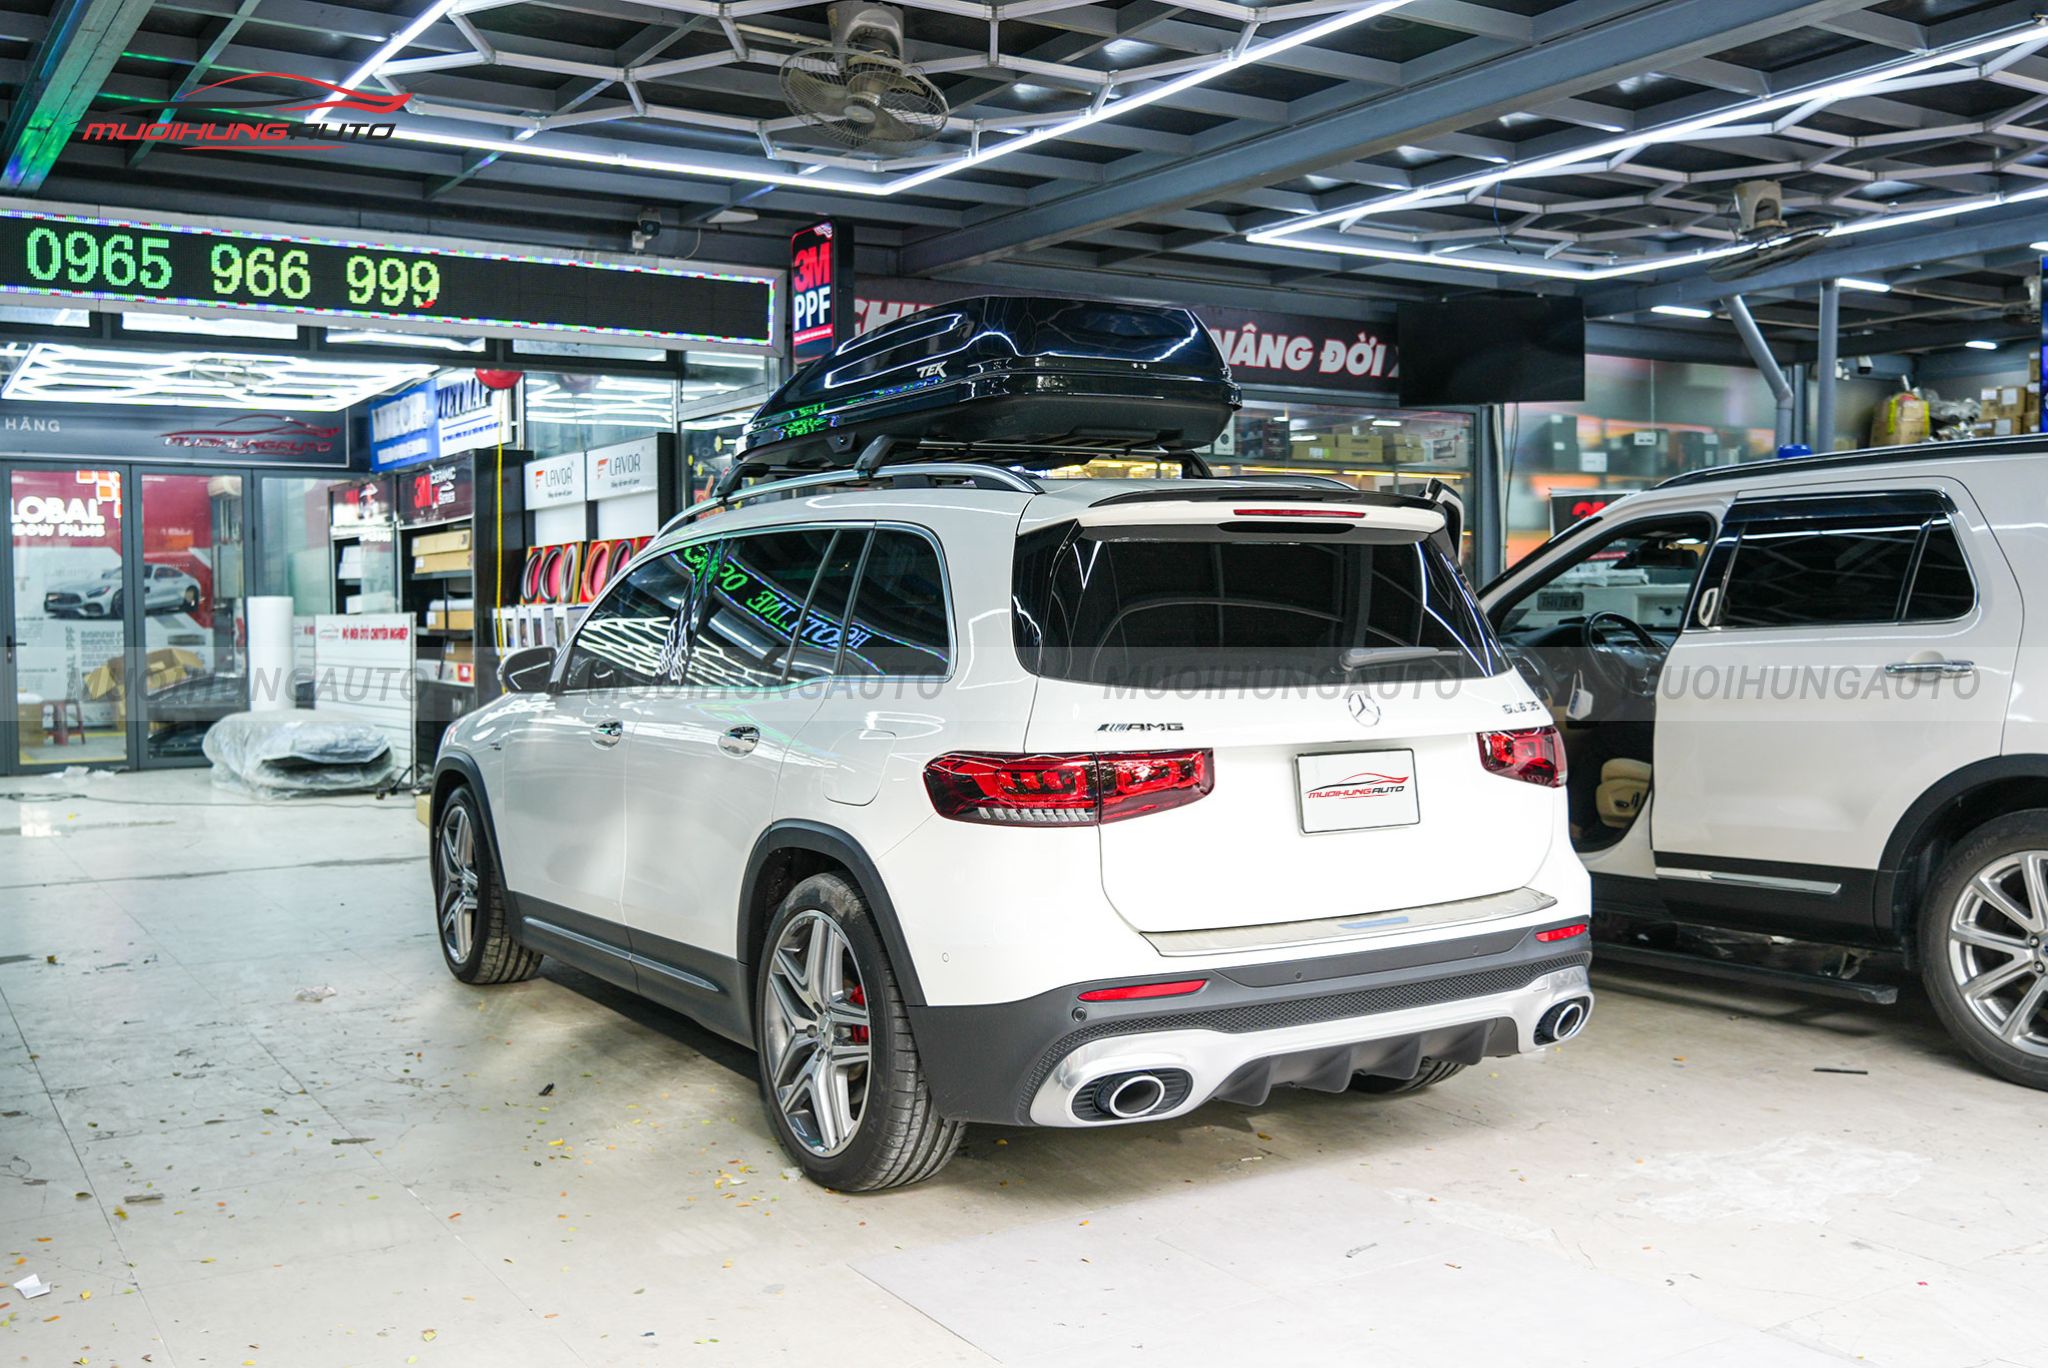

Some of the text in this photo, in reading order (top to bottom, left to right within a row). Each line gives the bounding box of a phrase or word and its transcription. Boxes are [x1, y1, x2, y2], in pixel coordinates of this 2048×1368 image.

[26, 226, 441, 309] 0965 966 999
[793, 241, 832, 293] 3M
[793, 285, 832, 333] PPF
[1318, 331, 1387, 378] ĐỜI
[609, 453, 641, 477] LAVOR
[10, 496, 105, 524] LOBAL
[1126, 722, 1185, 732] AMG
[1308, 785, 1405, 799] MUOIHUNGAUTO
